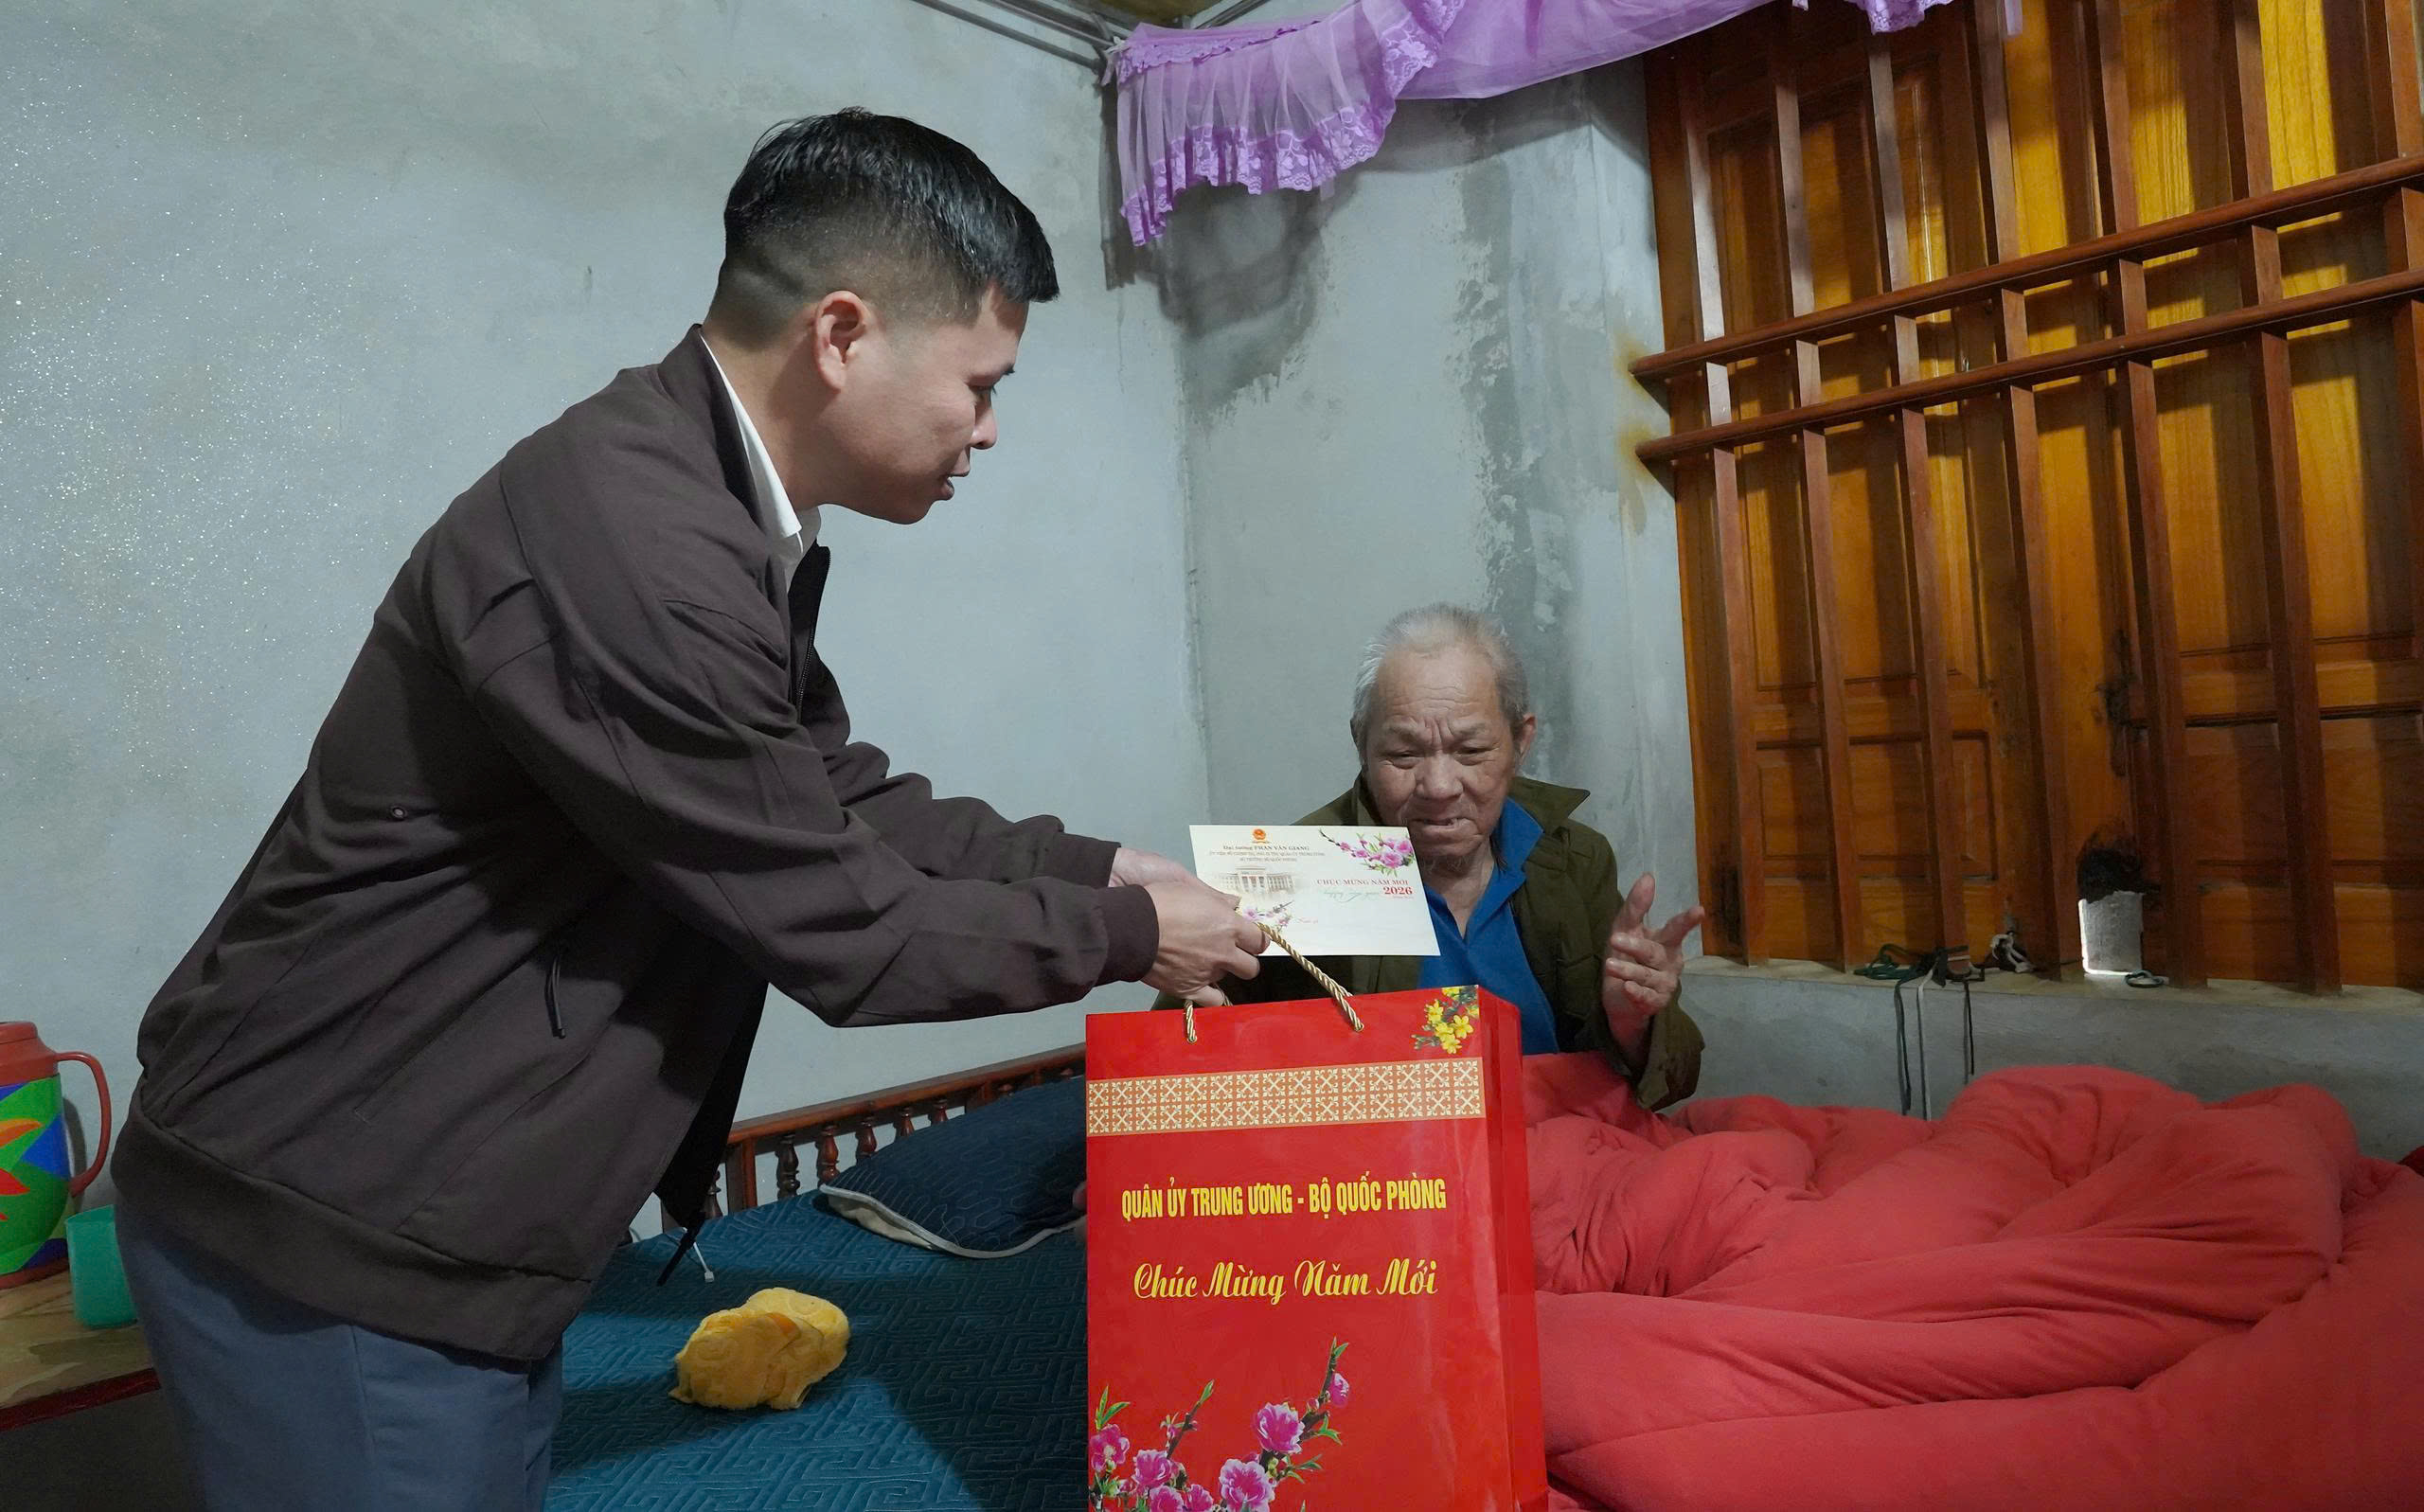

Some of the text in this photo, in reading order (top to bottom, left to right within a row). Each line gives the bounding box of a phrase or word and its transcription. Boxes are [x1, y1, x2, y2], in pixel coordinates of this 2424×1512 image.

[1382, 886, 1413, 895] 2026
[1121, 1183, 1164, 1221] QUÂN
[1167, 1177, 1187, 1218] ỦY
[1190, 1185, 1243, 1217] TRUNG
[1247, 1183, 1293, 1215] ƯƠNG
[1309, 1177, 1331, 1218] BỘ
[1335, 1170, 1382, 1216] QUỐC
[1386, 1172, 1447, 1211] PHÒNG
[1133, 1257, 1439, 1306] Chúc Mừng Năm Mới
